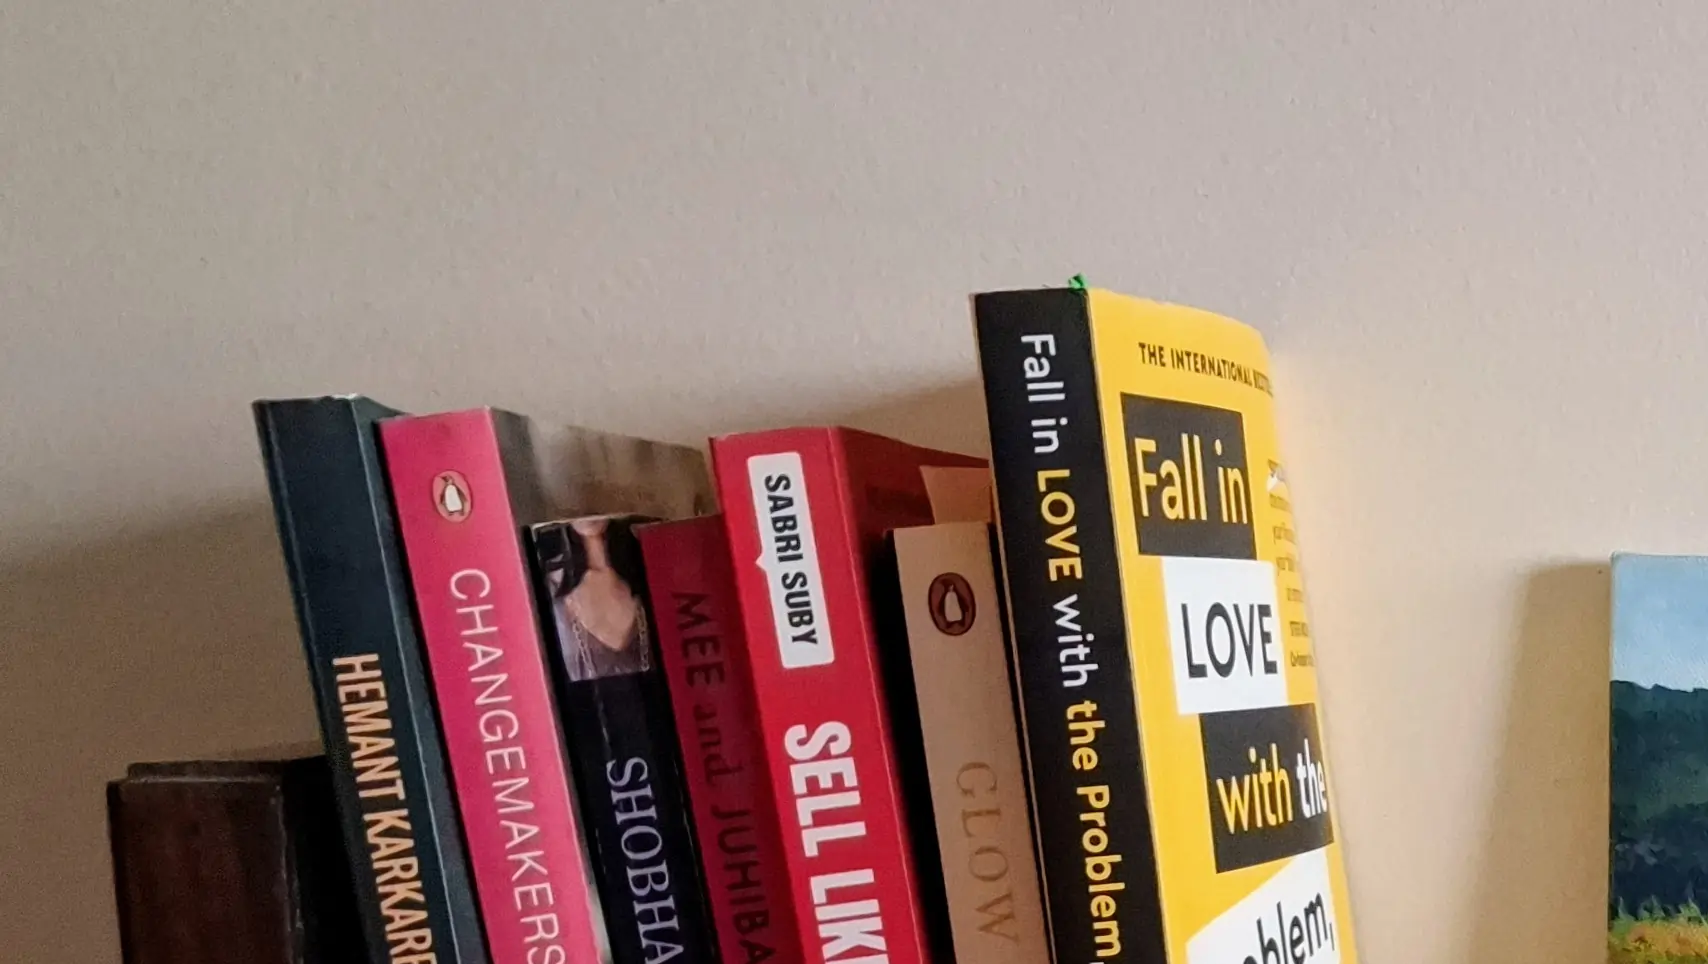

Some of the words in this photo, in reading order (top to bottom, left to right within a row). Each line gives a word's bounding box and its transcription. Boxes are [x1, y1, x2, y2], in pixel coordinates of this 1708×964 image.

[1020, 333, 1066, 404] Fall
[1138, 342, 1166, 367] THE
[1171, 348, 1253, 387] INTERNATIONAL
[1031, 416, 1068, 454] in
[1134, 433, 1207, 520] Fall
[1216, 440, 1248, 525] in
[764, 474, 802, 563] SABRI
[1037, 469, 1083, 582] LOVE
[674, 591, 725, 690] MEE
[781, 574, 818, 646] SUBY
[1053, 595, 1099, 688] with
[1181, 602, 1278, 679] LOVE
[333, 653, 405, 799] HEMANT
[693, 703, 744, 785] and
[1067, 701, 1105, 771] the
[784, 721, 867, 857] SELL
[1217, 743, 1294, 835] with
[1297, 738, 1328, 818] the
[956, 761, 1018, 943] GLOW
